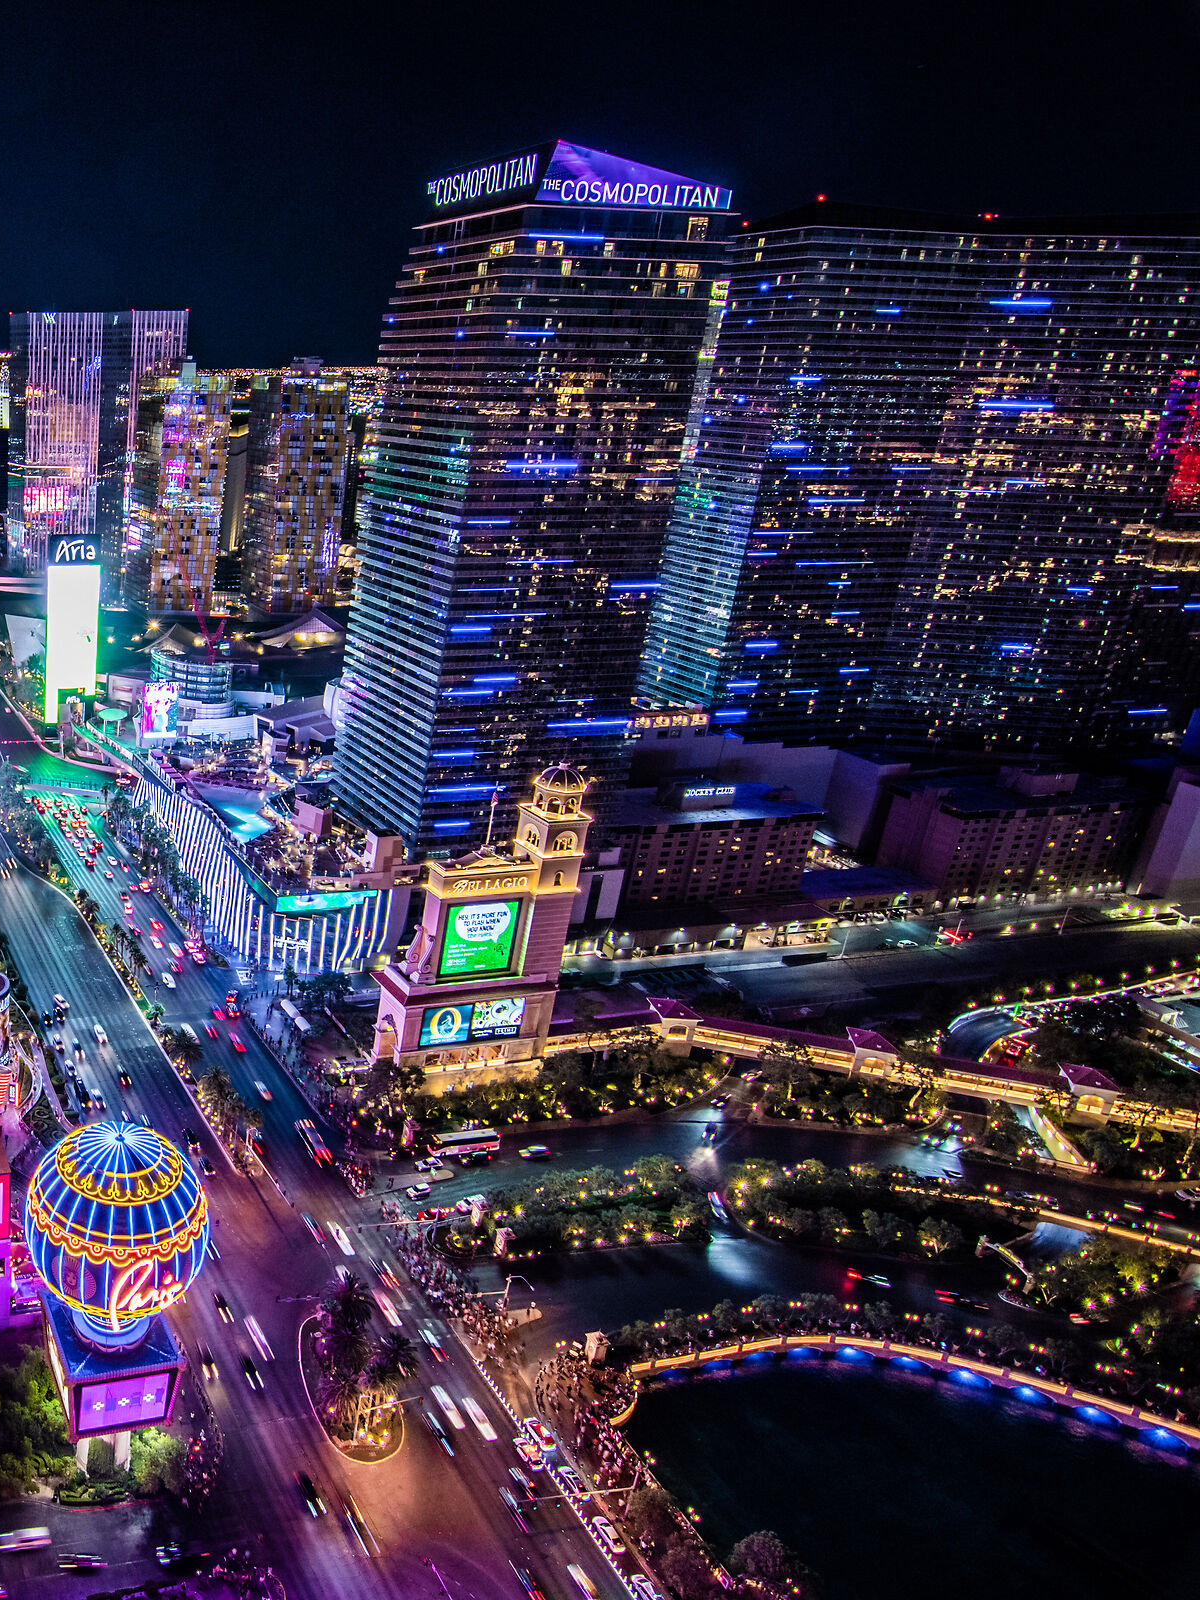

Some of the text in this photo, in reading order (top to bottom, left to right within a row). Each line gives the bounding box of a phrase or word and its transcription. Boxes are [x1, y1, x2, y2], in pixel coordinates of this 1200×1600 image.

[427, 153, 538, 207] THE COSMOPOLITAN
[542, 178, 720, 208] THE COSMOPOLITAN
[55, 539, 96, 563] Aria
[684, 786, 736, 797] JOCKEY CLUB
[448, 876, 528, 893] BELLAGIO
[109, 1258, 183, 1332] Paris
